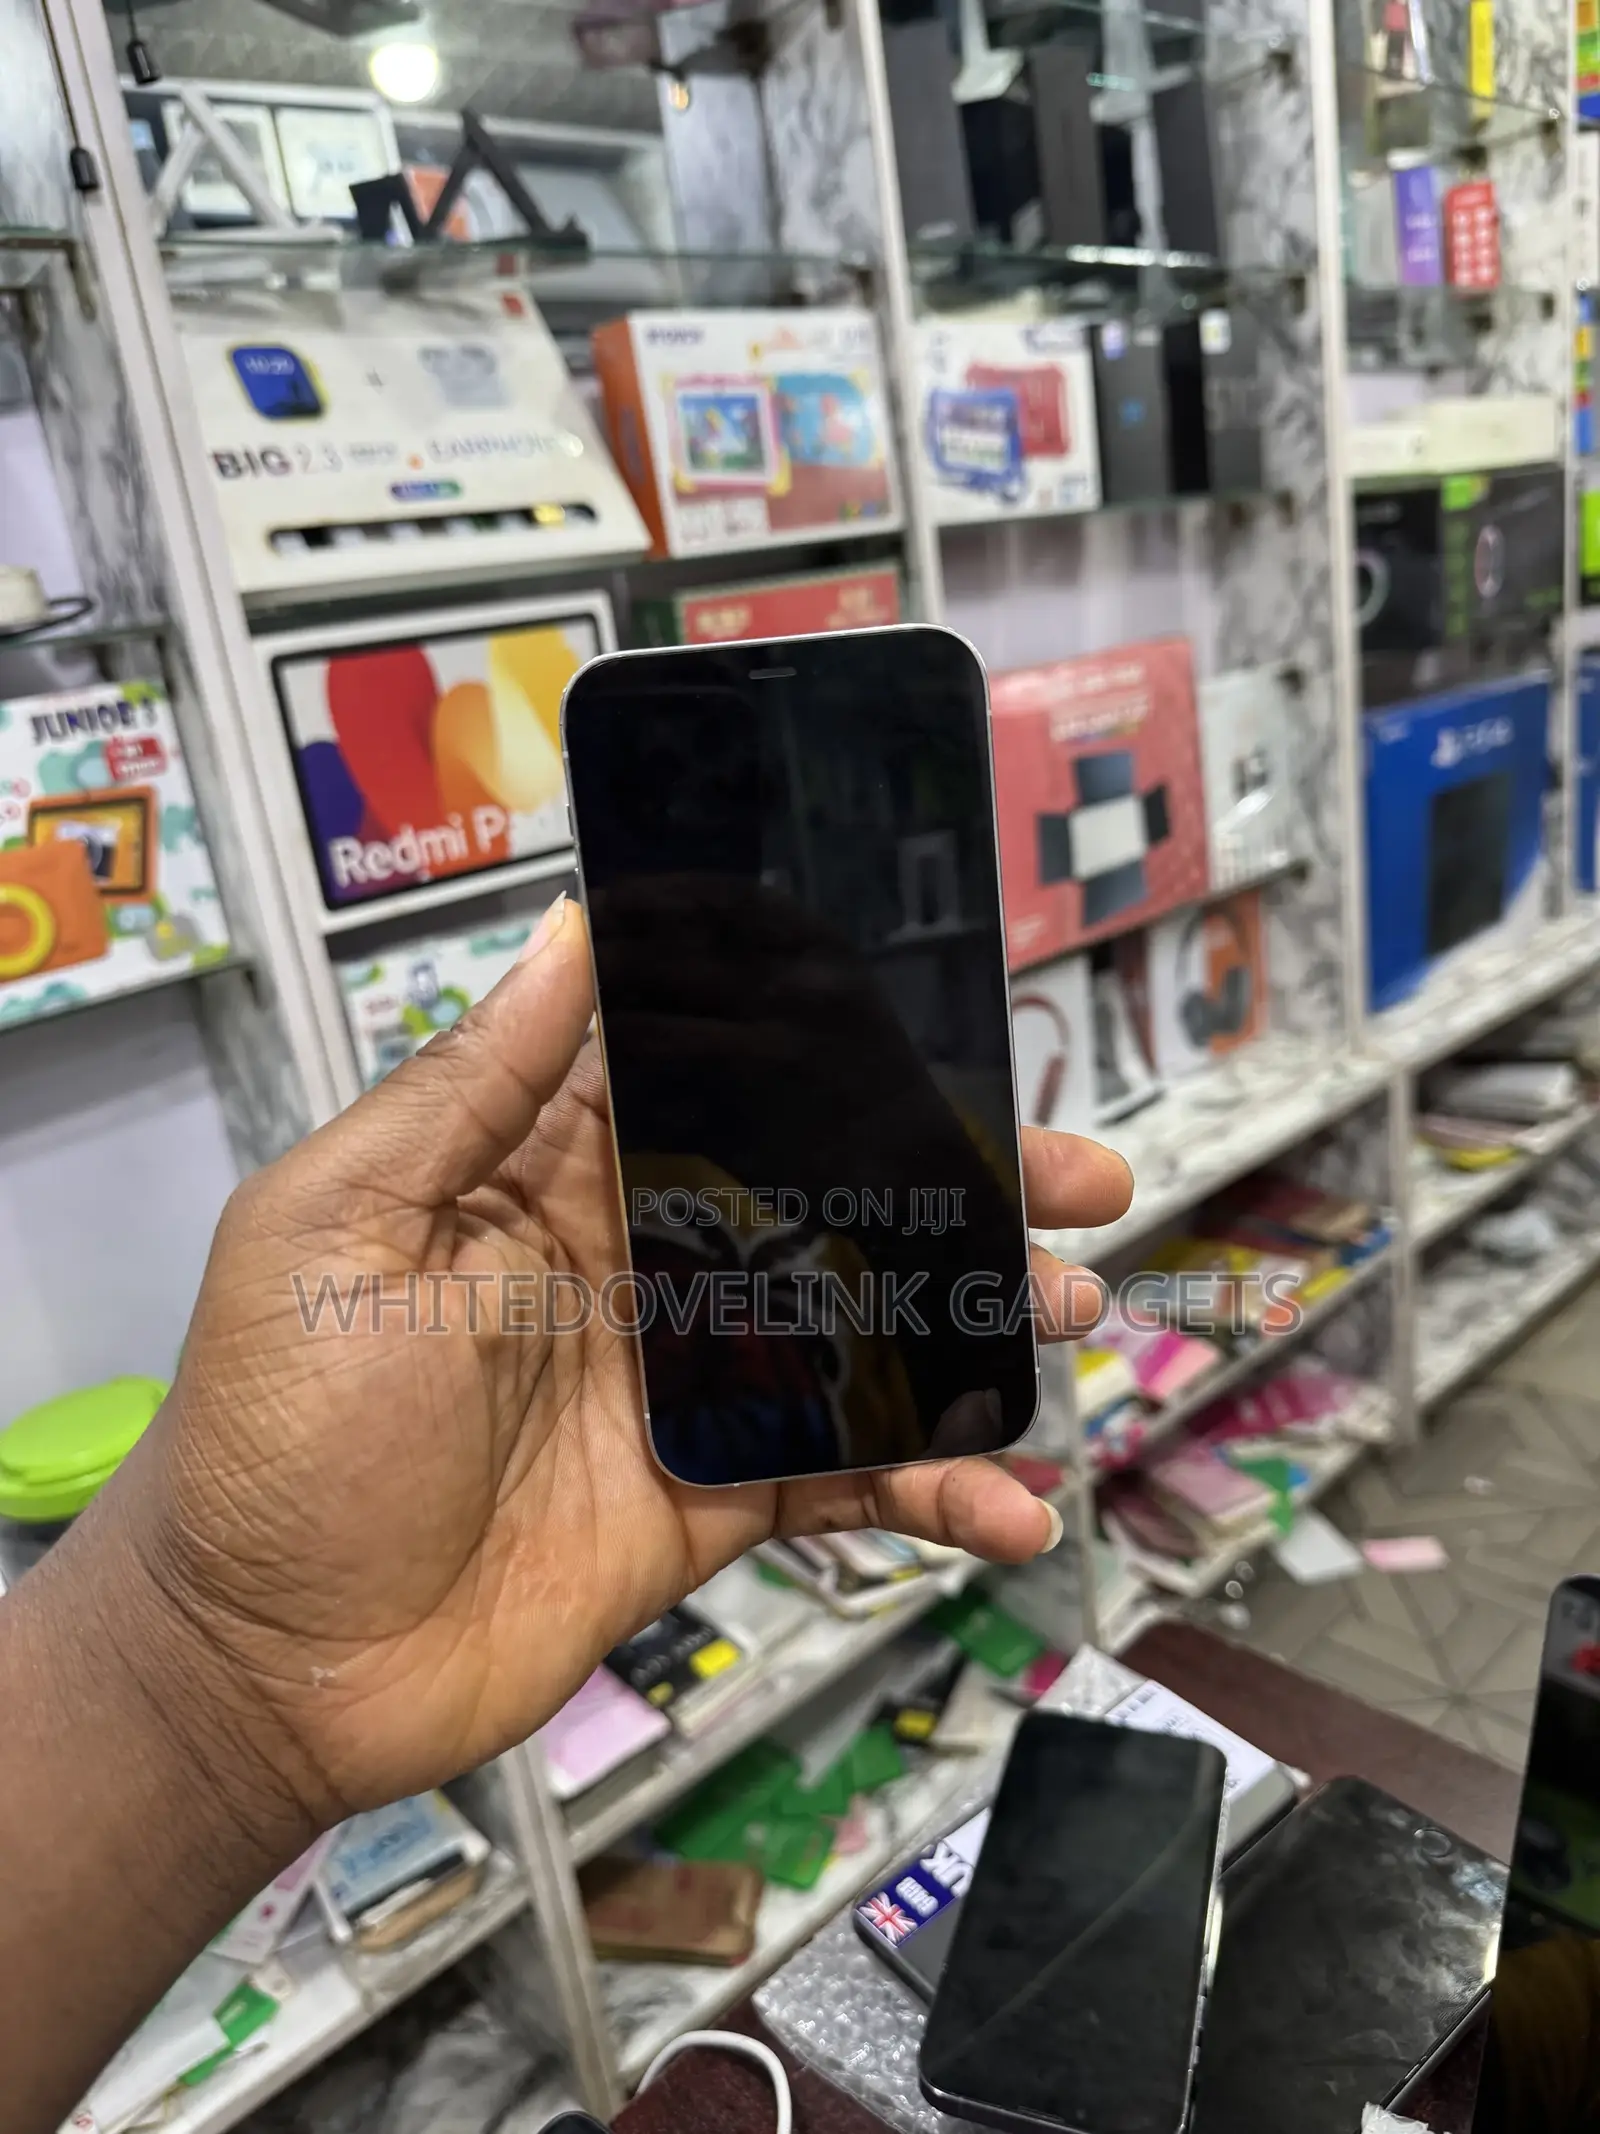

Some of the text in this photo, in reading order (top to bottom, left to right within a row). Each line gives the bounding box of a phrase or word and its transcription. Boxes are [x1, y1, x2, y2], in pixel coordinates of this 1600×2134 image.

[212, 446, 290, 479] BIG
[329, 811, 469, 888] Redmi
[920, 1840, 975, 1898] UK
